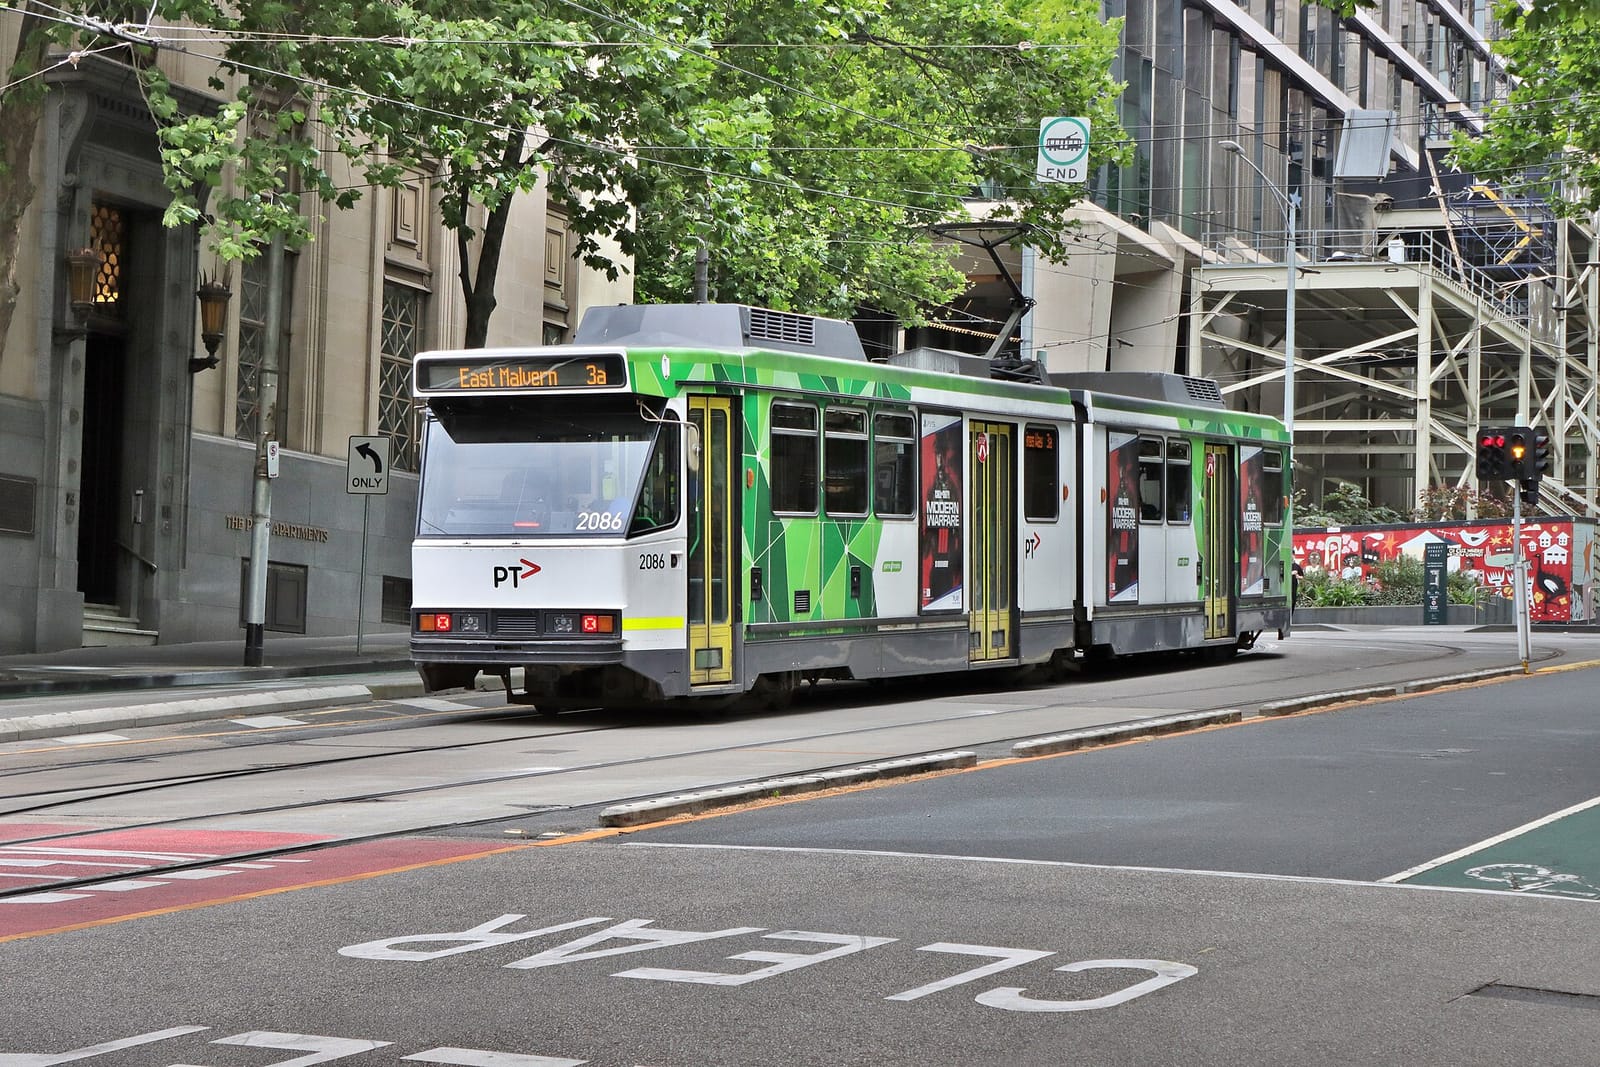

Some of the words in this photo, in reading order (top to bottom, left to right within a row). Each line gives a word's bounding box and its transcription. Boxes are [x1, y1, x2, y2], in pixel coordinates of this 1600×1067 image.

[1046, 168, 1078, 179] END
[458, 366, 496, 388] East
[499, 366, 558, 388] Malvern
[585, 364, 607, 385] 3a
[352, 477, 382, 488] ONLY
[926, 501, 959, 514] MODERN
[1112, 507, 1136, 518] MODERN
[575, 511, 622, 530] 2086
[926, 514, 960, 527] WARFARE
[225, 515, 245, 529] THE
[271, 523, 329, 543] APARTMENTS
[639, 553, 665, 570] 2086
[337, 913, 1198, 1013] CLEAR
